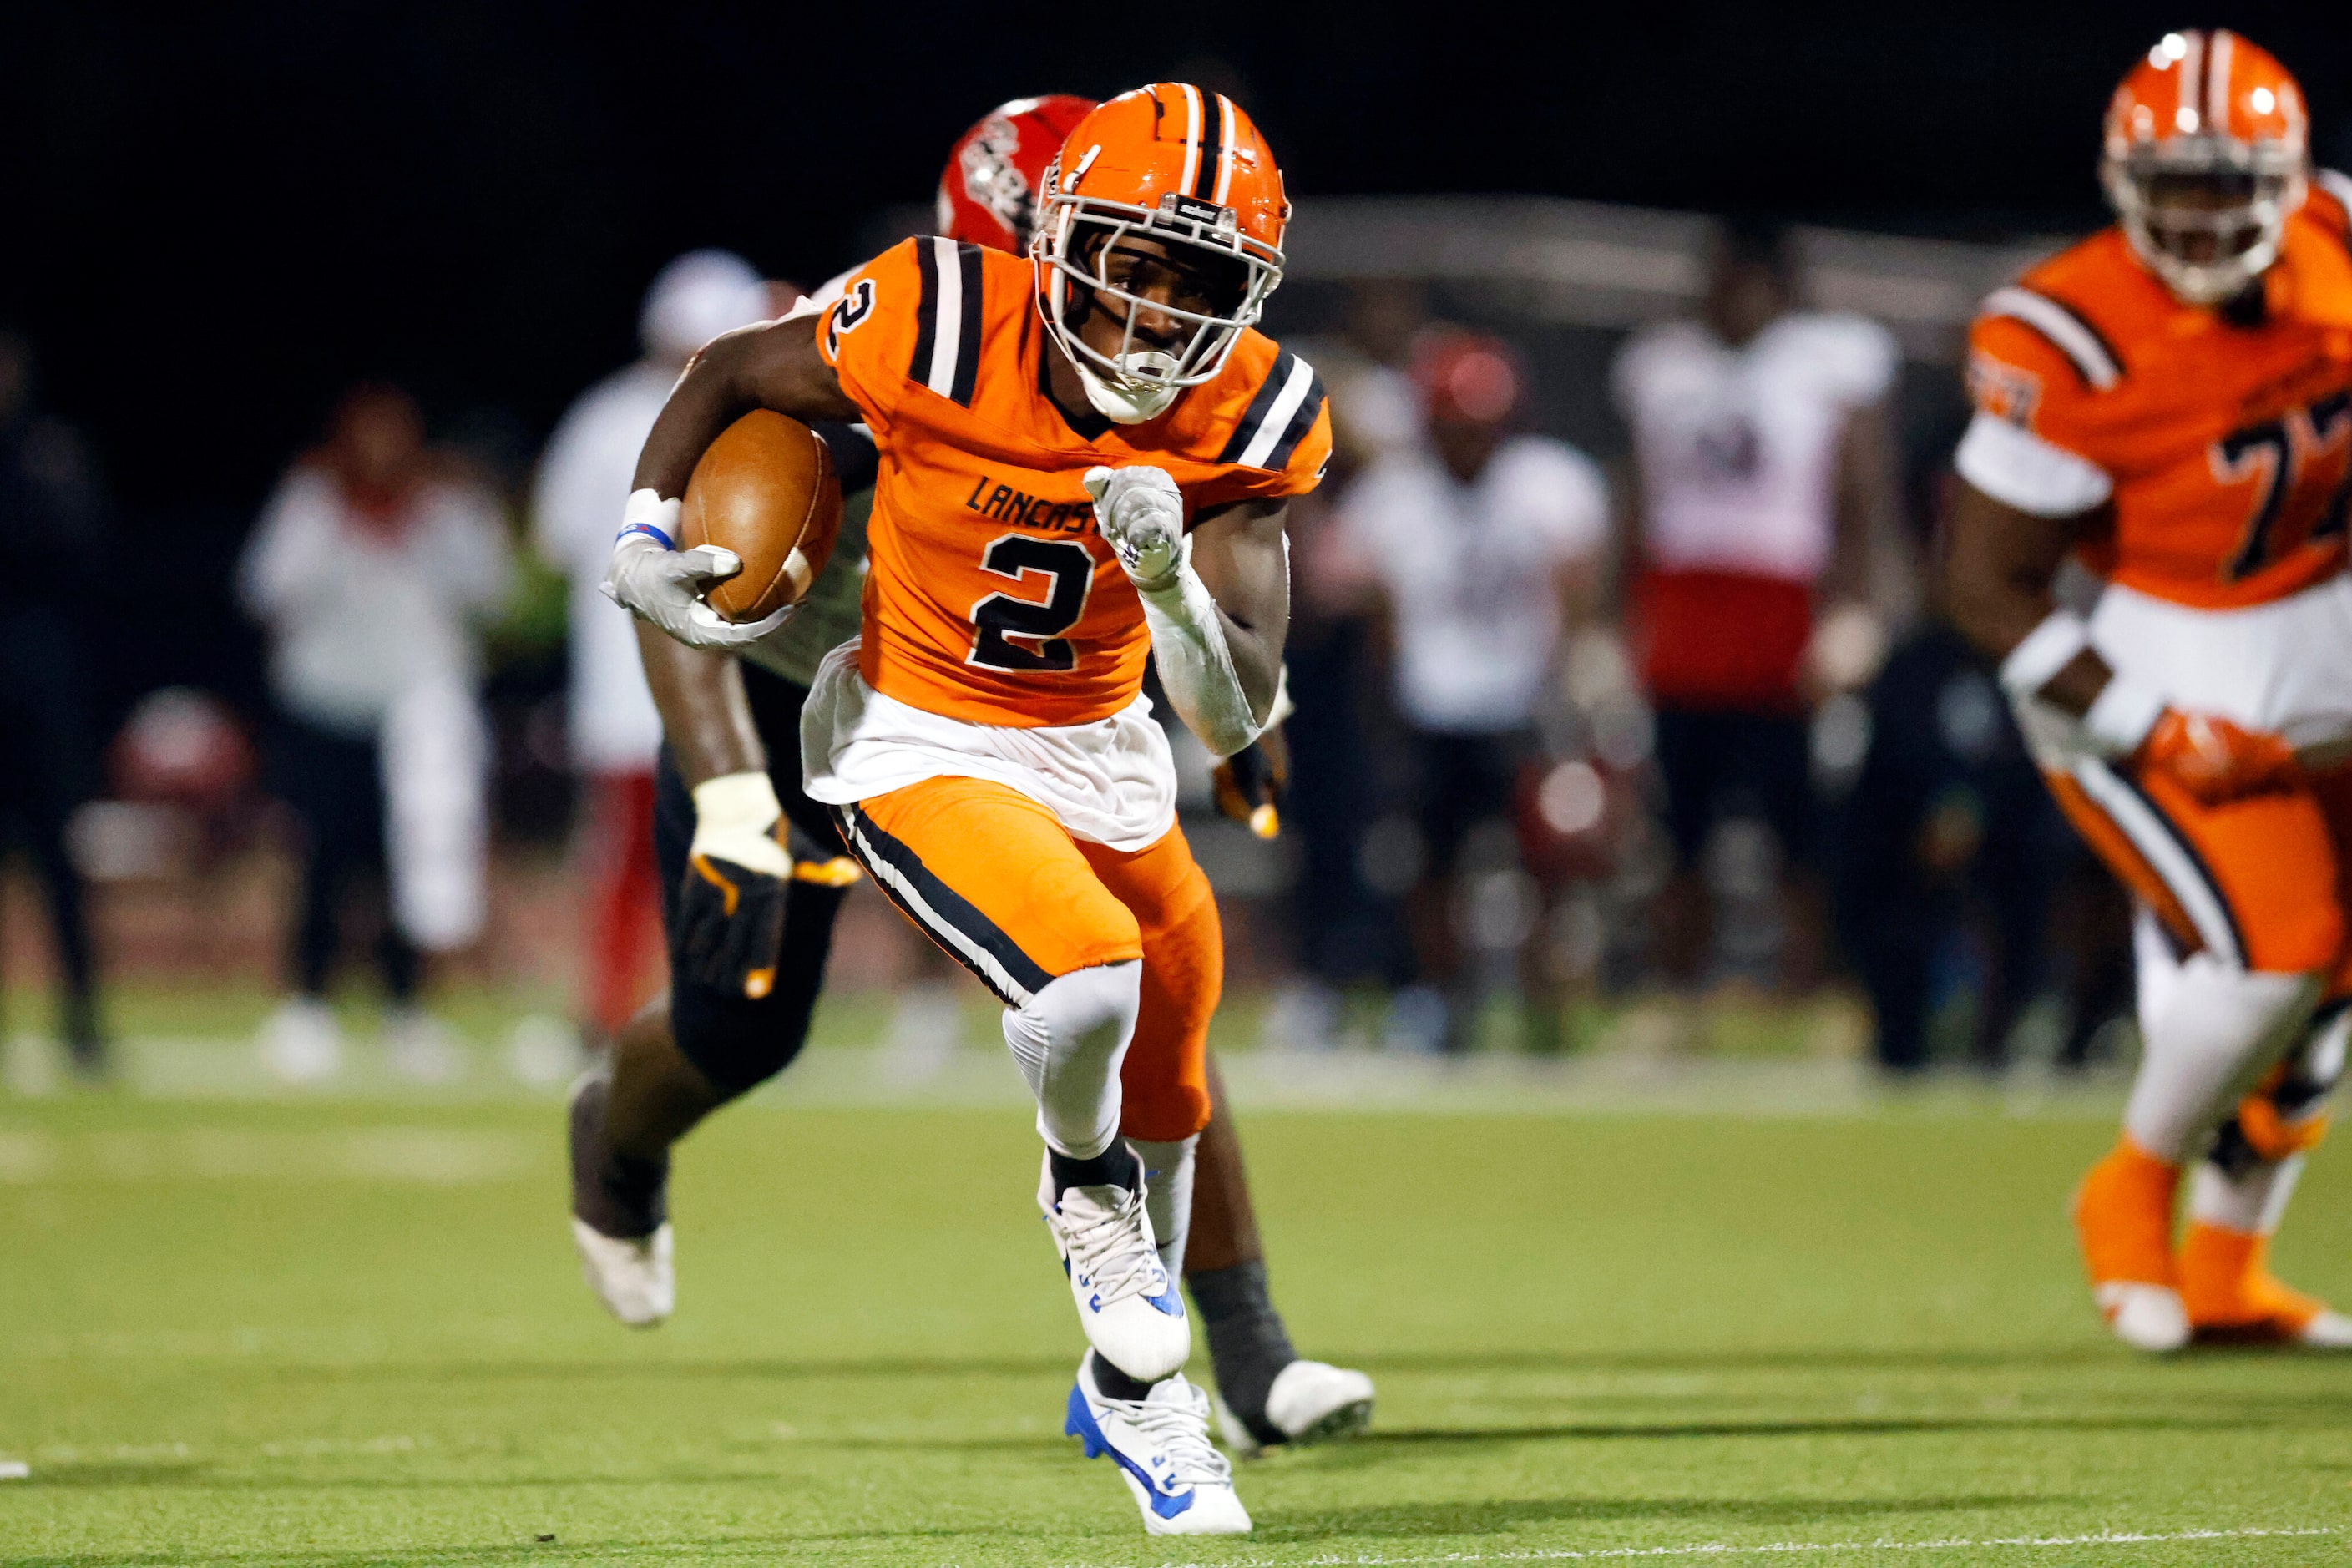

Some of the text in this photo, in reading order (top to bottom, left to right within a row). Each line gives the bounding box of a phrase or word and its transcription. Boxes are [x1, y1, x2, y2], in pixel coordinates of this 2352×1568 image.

[825, 278, 876, 362] 2
[966, 476, 1100, 534] LANCAS
[964, 532, 1095, 673] 2
